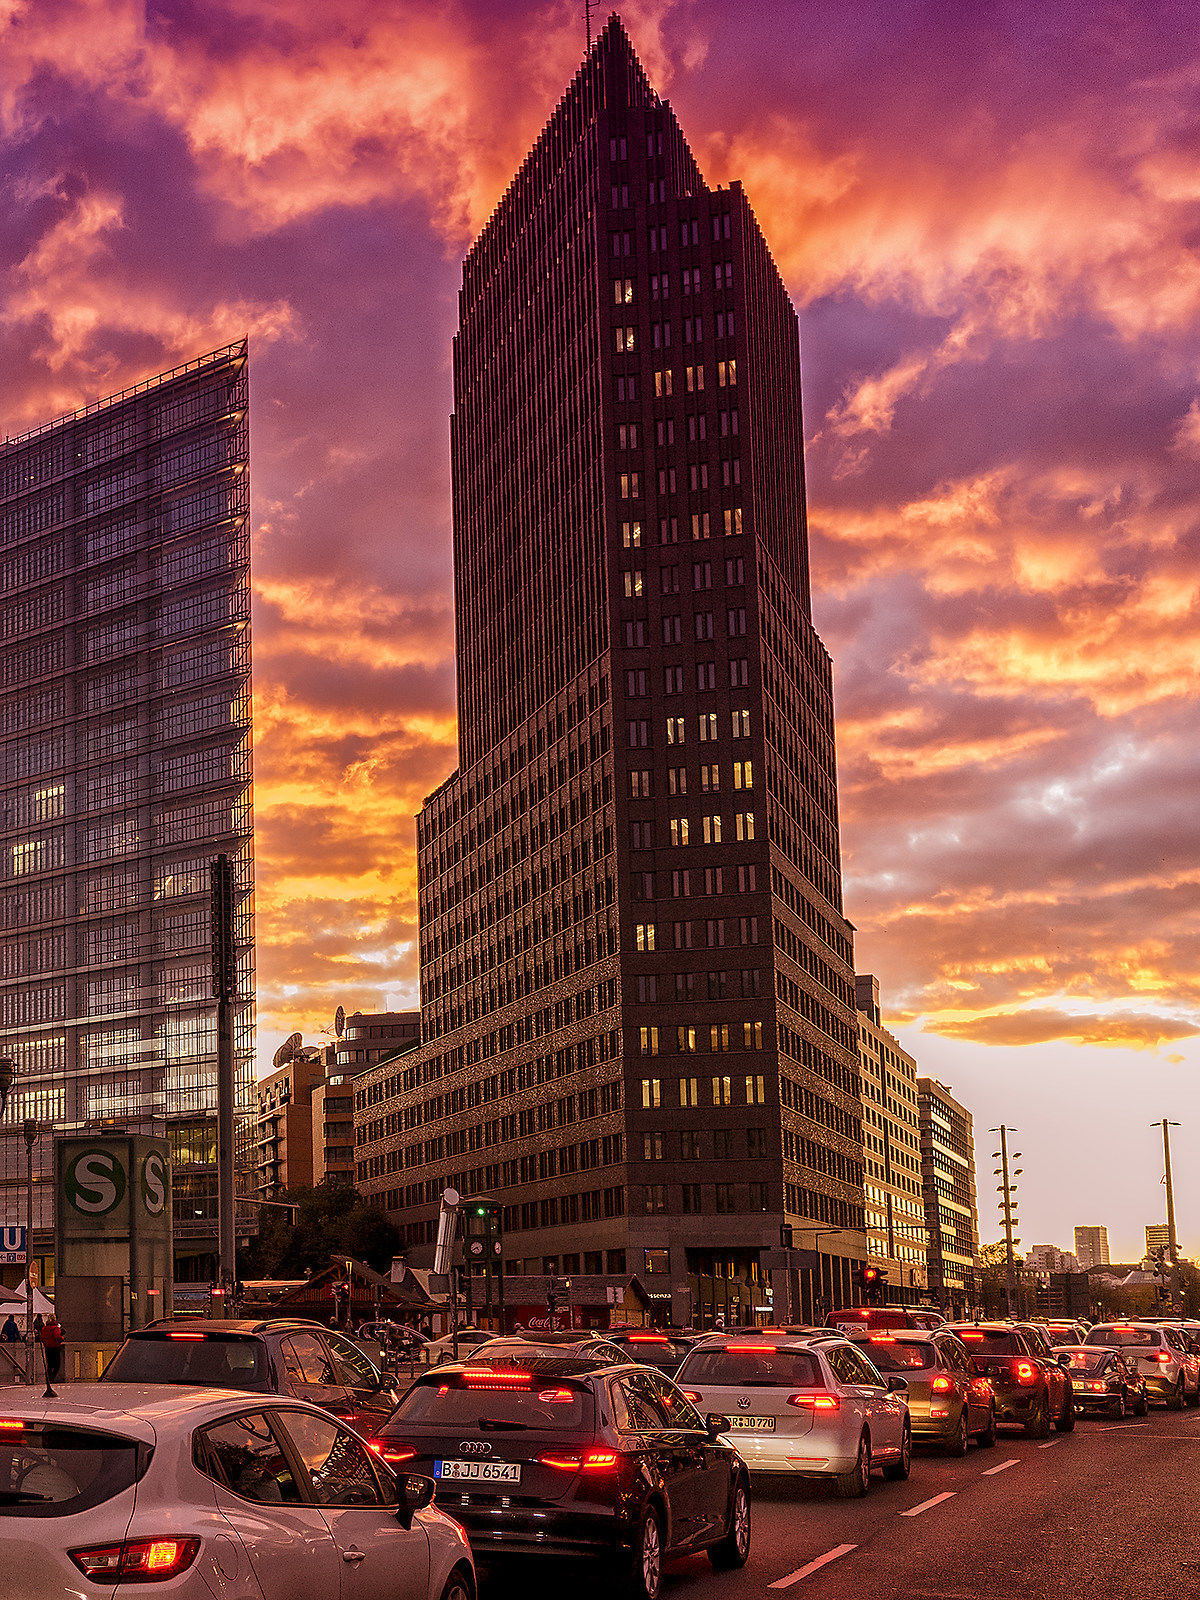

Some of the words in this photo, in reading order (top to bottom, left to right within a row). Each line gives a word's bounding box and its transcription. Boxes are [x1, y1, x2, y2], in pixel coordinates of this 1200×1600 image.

[3, 1227, 22, 1250] U
[757, 1418, 774, 1428] 770
[442, 1462, 452, 1477] B
[461, 1463, 480, 1478] JJ
[483, 1464, 519, 1480] 6541
